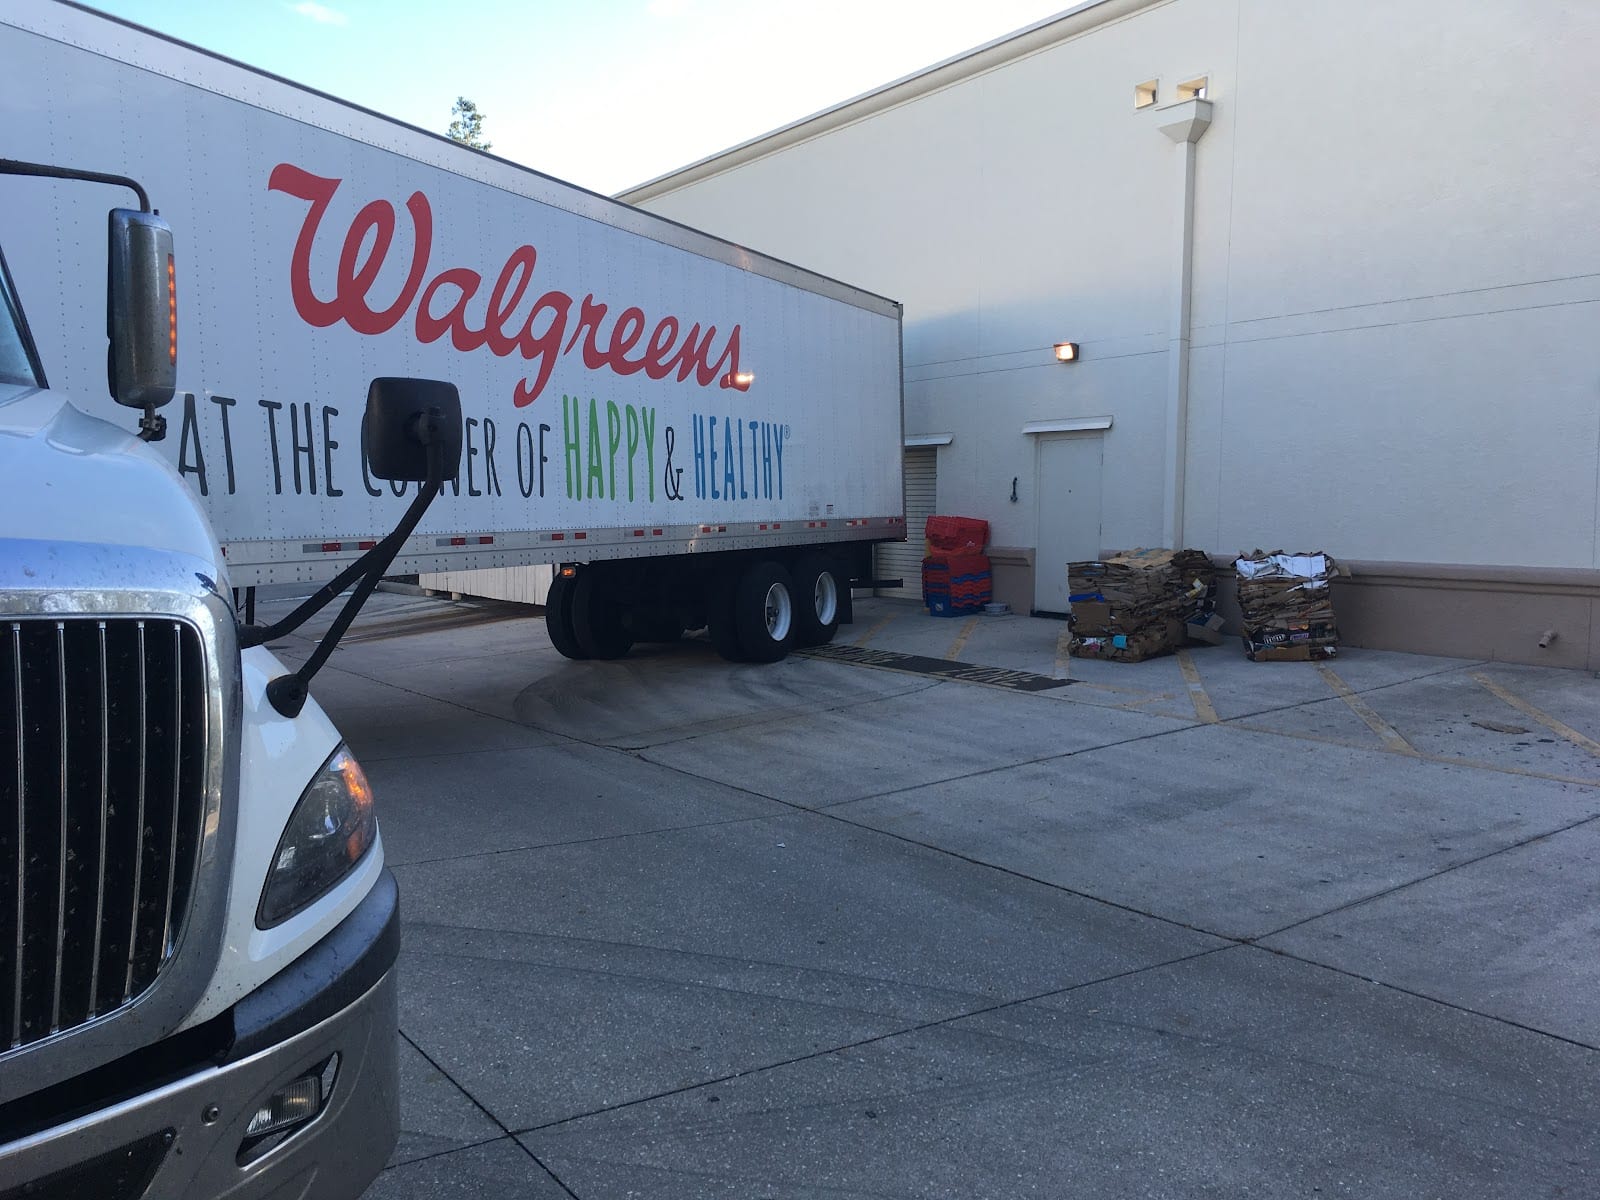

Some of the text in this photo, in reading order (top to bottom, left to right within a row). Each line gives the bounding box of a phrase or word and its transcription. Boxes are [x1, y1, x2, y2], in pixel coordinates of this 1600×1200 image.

[268, 163, 754, 407] Walgreens
[178, 393, 237, 497] AT
[258, 399, 343, 497] THE
[361, 411, 502, 497] CER
[516, 422, 551, 498] OF
[562, 394, 656, 503] HAPPY
[664, 426, 684, 501] &
